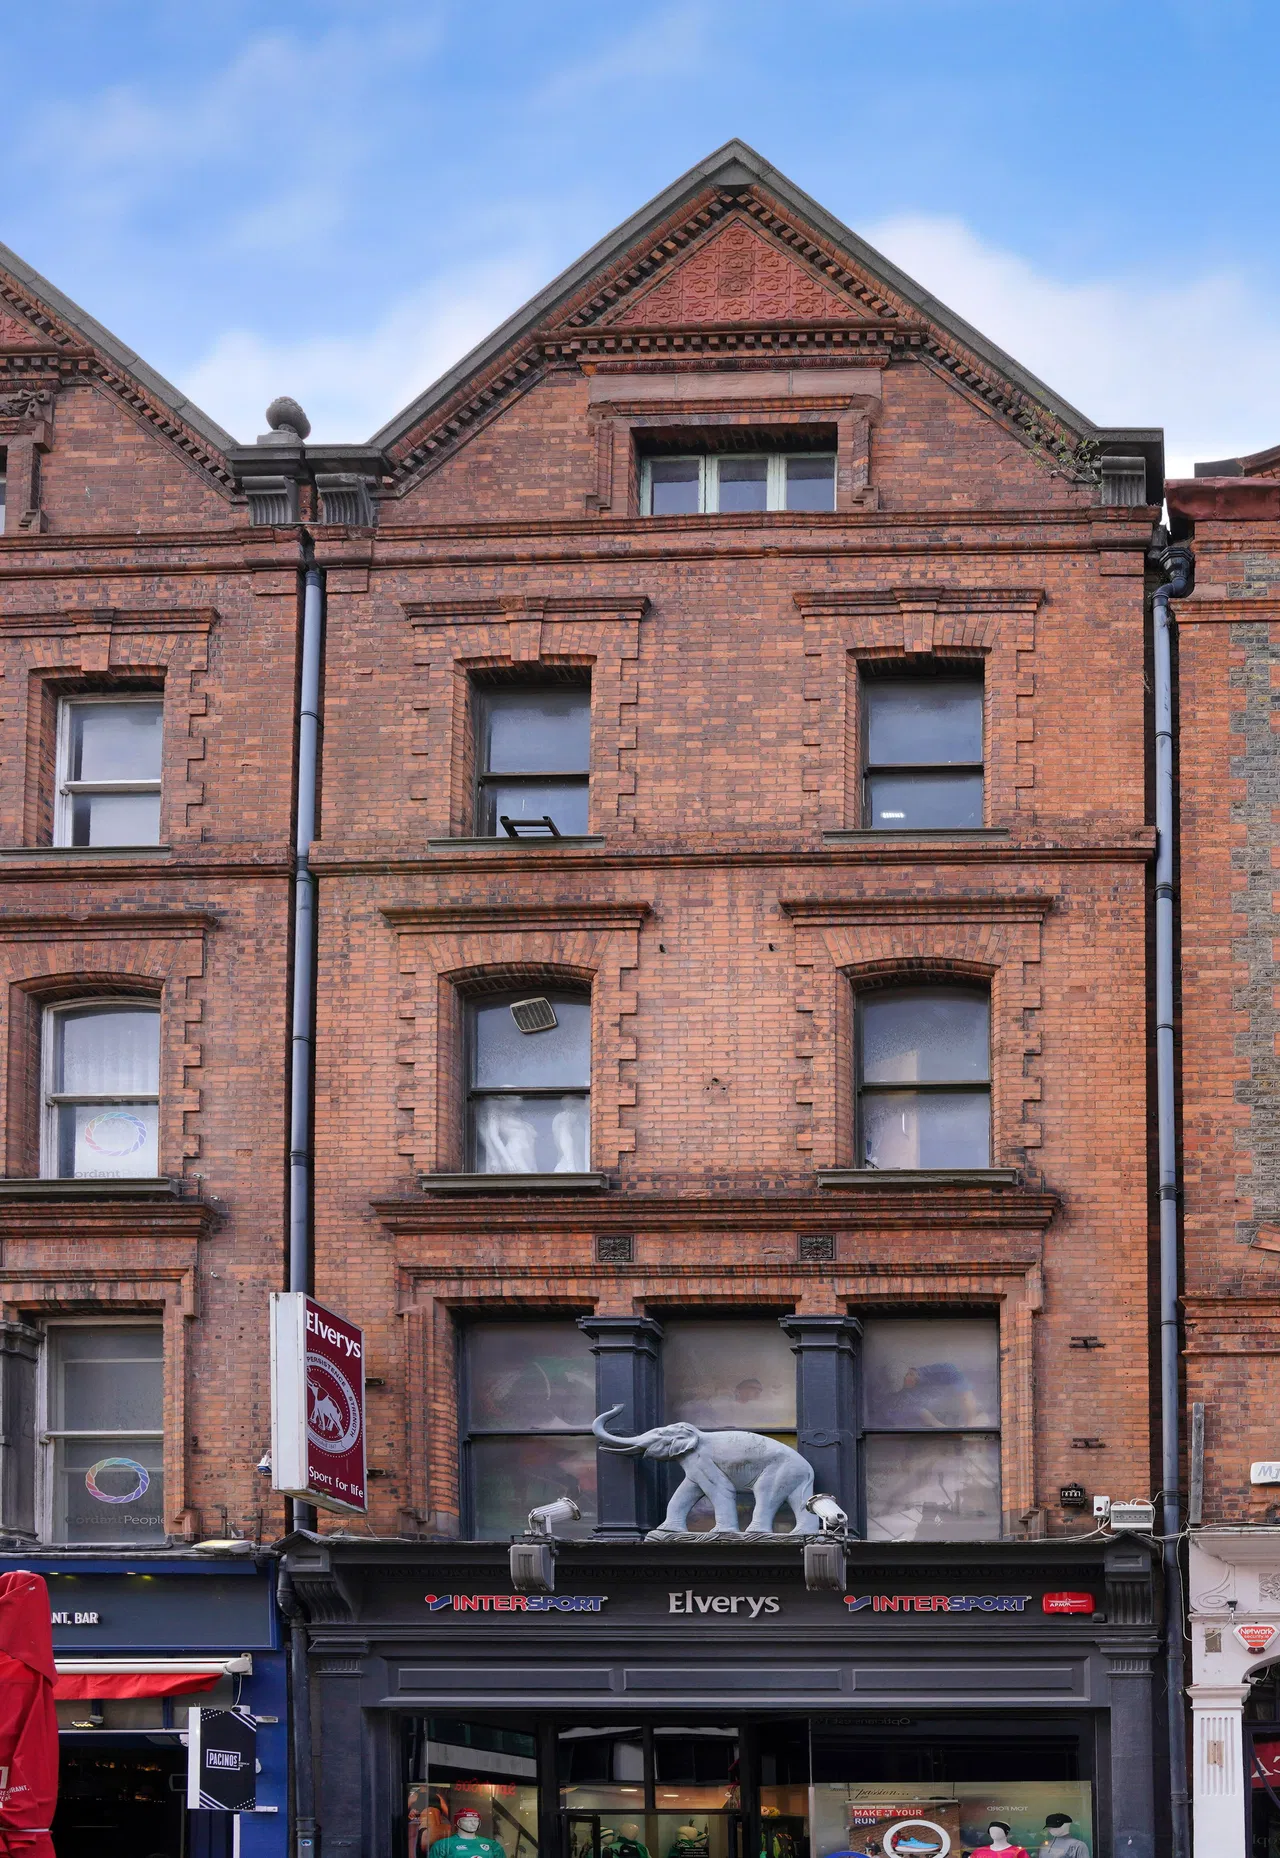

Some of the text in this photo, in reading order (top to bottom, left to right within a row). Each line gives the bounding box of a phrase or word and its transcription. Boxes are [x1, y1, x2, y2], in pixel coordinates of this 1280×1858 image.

[306, 1310, 362, 1358] Elverys
[306, 1356, 358, 1438] PERSISTENCE STRENGTH
[308, 1466, 363, 1498] Sport for life
[453, 1595, 603, 1611] INTERSPORT
[668, 1590, 780, 1618] Elverys
[873, 1595, 1029, 1612] INTERSPORT
[74, 1612, 99, 1624] BAR
